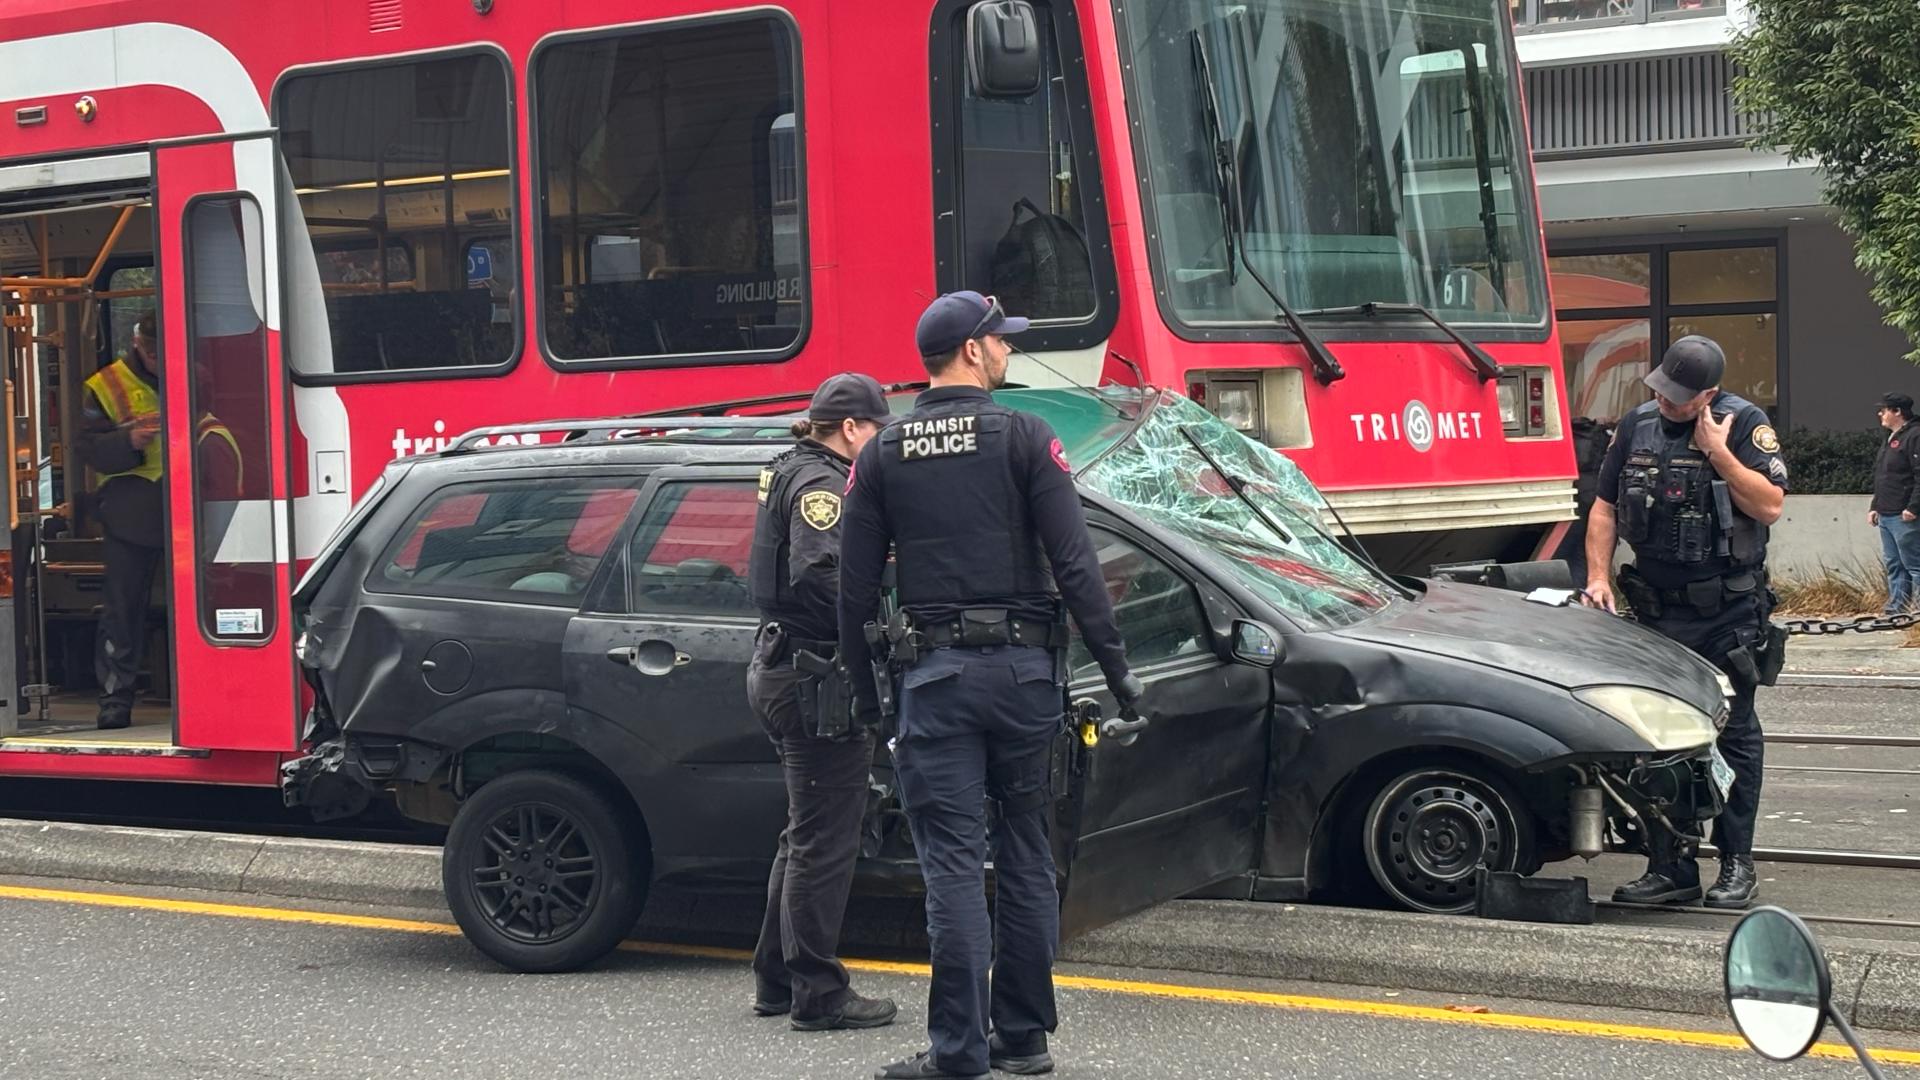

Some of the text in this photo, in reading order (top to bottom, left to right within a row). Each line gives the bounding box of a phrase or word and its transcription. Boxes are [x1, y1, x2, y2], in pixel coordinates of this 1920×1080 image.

[1444, 274, 1467, 305] 61
[902, 416, 975, 437] TRANSIT
[1350, 412, 1482, 442] TRI MET
[902, 433, 977, 458] POLICE
